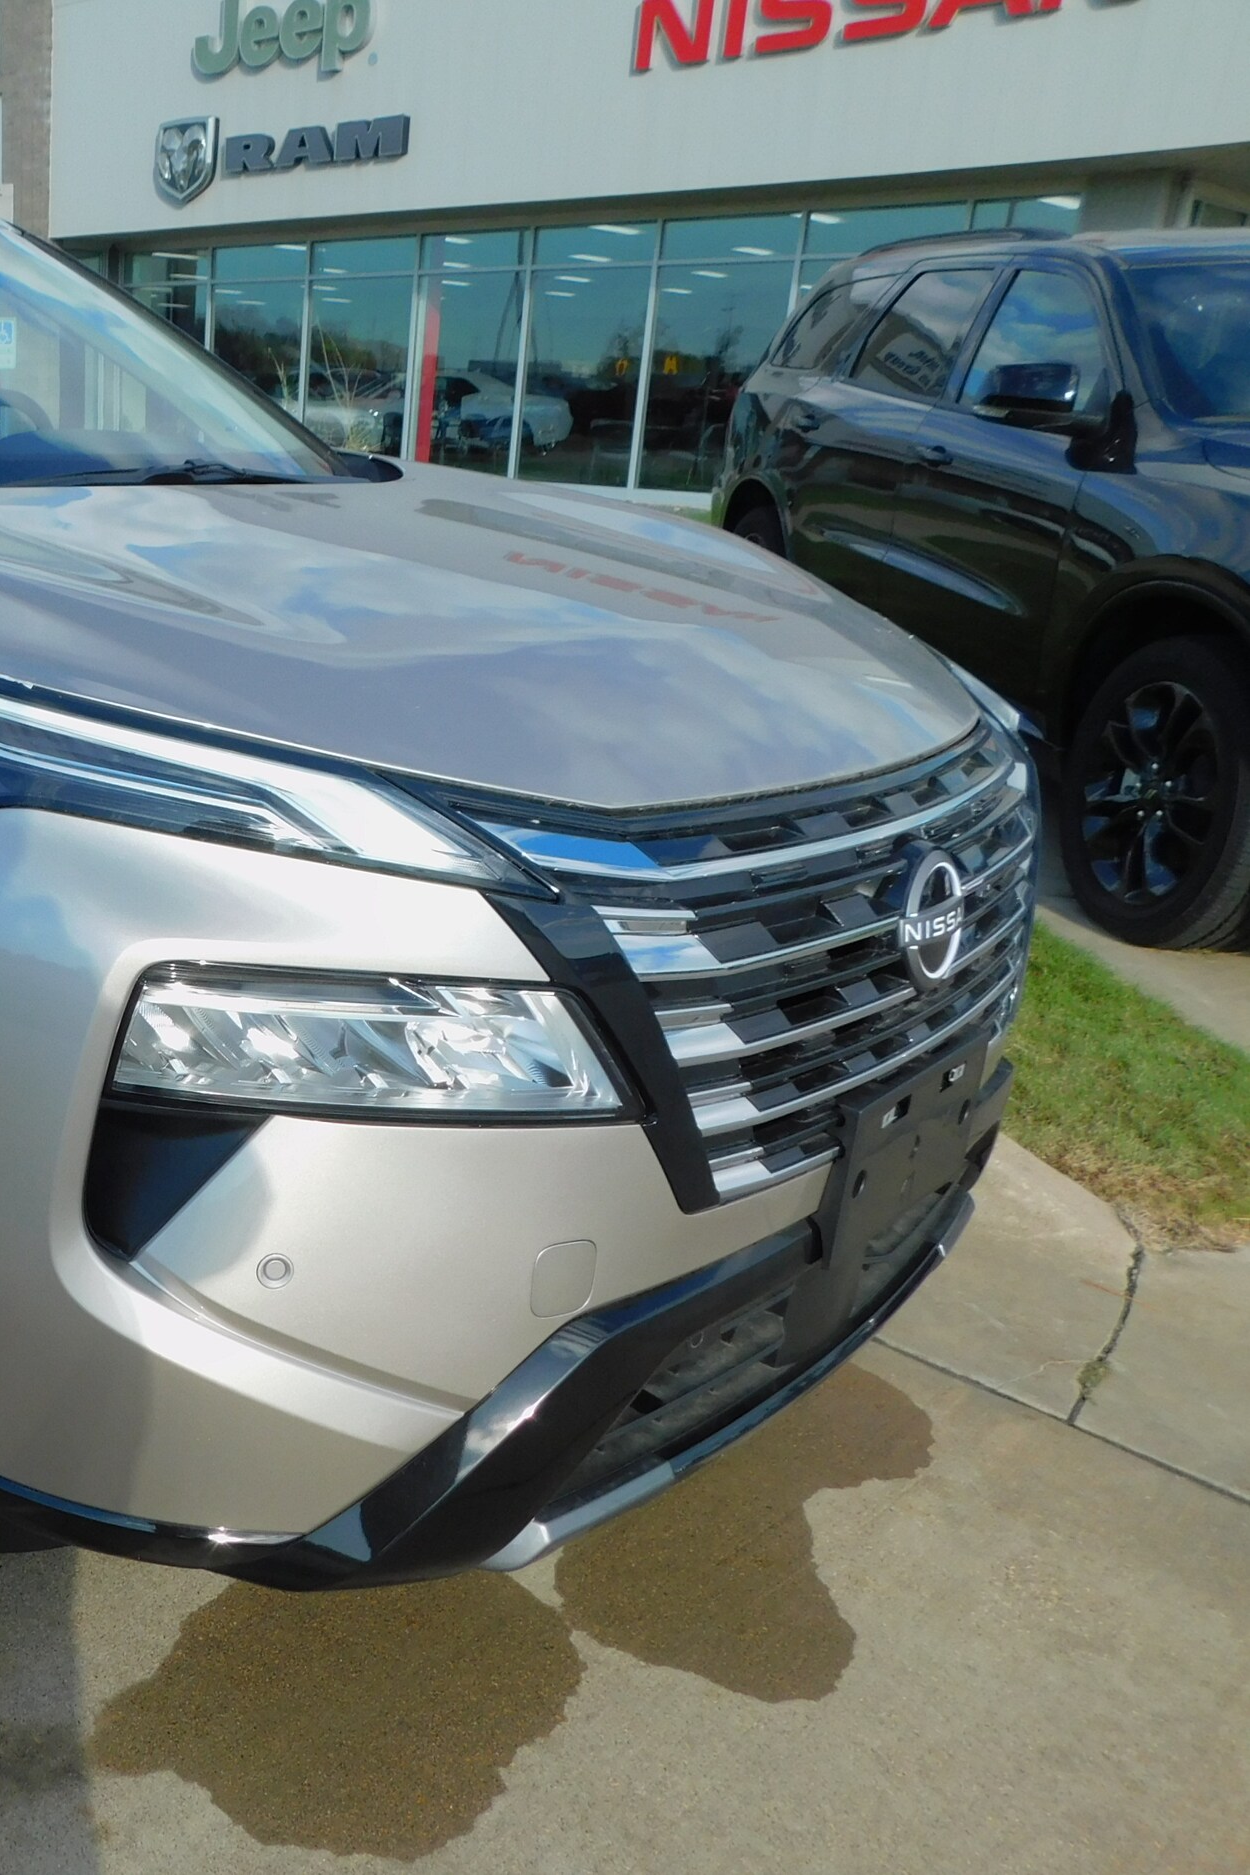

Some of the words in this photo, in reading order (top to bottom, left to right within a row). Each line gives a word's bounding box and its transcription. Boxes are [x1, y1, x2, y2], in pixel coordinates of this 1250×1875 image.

[194, 0, 372, 75] Jeep
[634, 0, 1063, 72] NISS
[225, 113, 411, 173] RAM
[904, 906, 963, 943] NISSA
